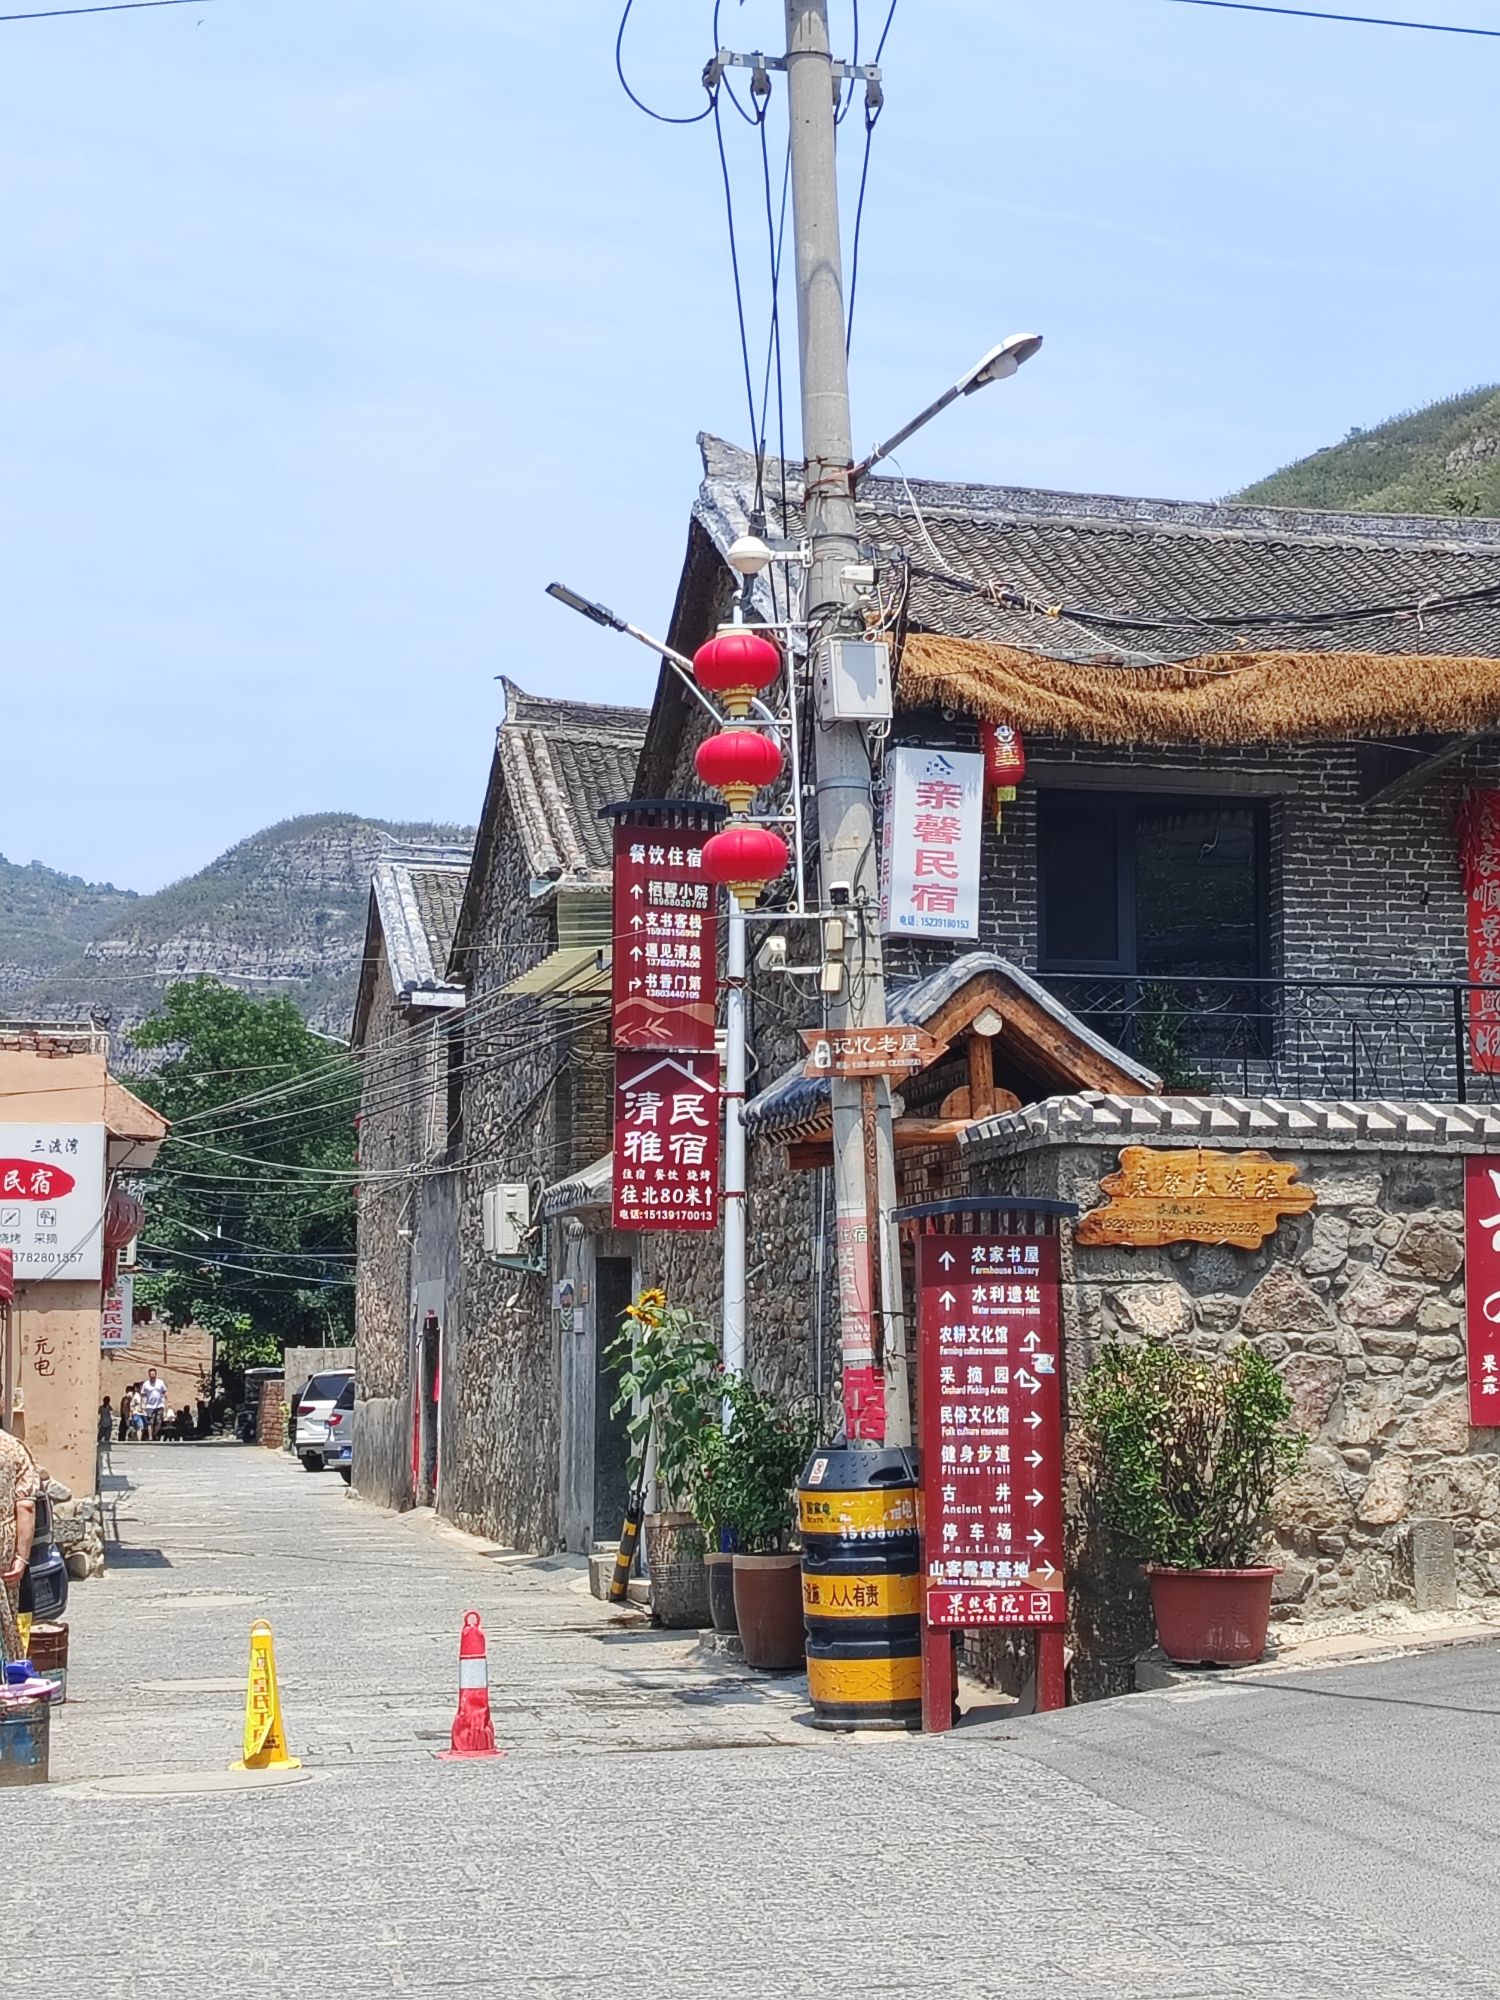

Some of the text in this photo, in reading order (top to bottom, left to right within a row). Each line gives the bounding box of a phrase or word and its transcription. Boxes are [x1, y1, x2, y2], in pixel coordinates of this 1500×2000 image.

[629, 844, 702, 868] 餐饮住宿
[910, 781, 963, 914] 亲馨民宿
[648, 880, 709, 901] 栖馨小院
[645, 911, 703, 930] 支书客栈
[645, 942, 702, 961] 遇见清泉
[645, 973, 702, 991] 书香门第
[832, 1034, 921, 1055] 记忆老屋
[3, 1169, 54, 1195] 民宿
[622, 1168, 711, 1182] 住宿 餐饮 烧烤
[620, 1184, 703, 1207] 往北80米
[619, 1209, 712, 1221] 电话:15139170013
[34, 1233, 58, 1244] 采摘
[971, 1246, 1039, 1263] 农家书屋
[971, 1265, 1039, 1276] Farmhouse Library
[971, 1285, 1041, 1303] 水利遗址
[939, 1325, 1008, 1343] 农耕文化馆
[34, 1336, 55, 1377] 充电
[940, 1366, 1009, 1384] 采摘园
[966, 1385, 990, 1397] Picking
[940, 1406, 1009, 1424] 民俗文化馆
[941, 1426, 956, 1436] Folk
[941, 1445, 1010, 1463] 健身步道
[941, 1465, 1010, 1475] Fitness trail
[942, 1504, 1011, 1514] Ancient well
[942, 1523, 1012, 1541] 停车场
[929, 1560, 1030, 1578] 山客露营基地
[970, 1579, 1007, 1588] camping
[829, 1584, 880, 1608] 人人有责
[946, 1593, 1020, 1616] 果然有院
